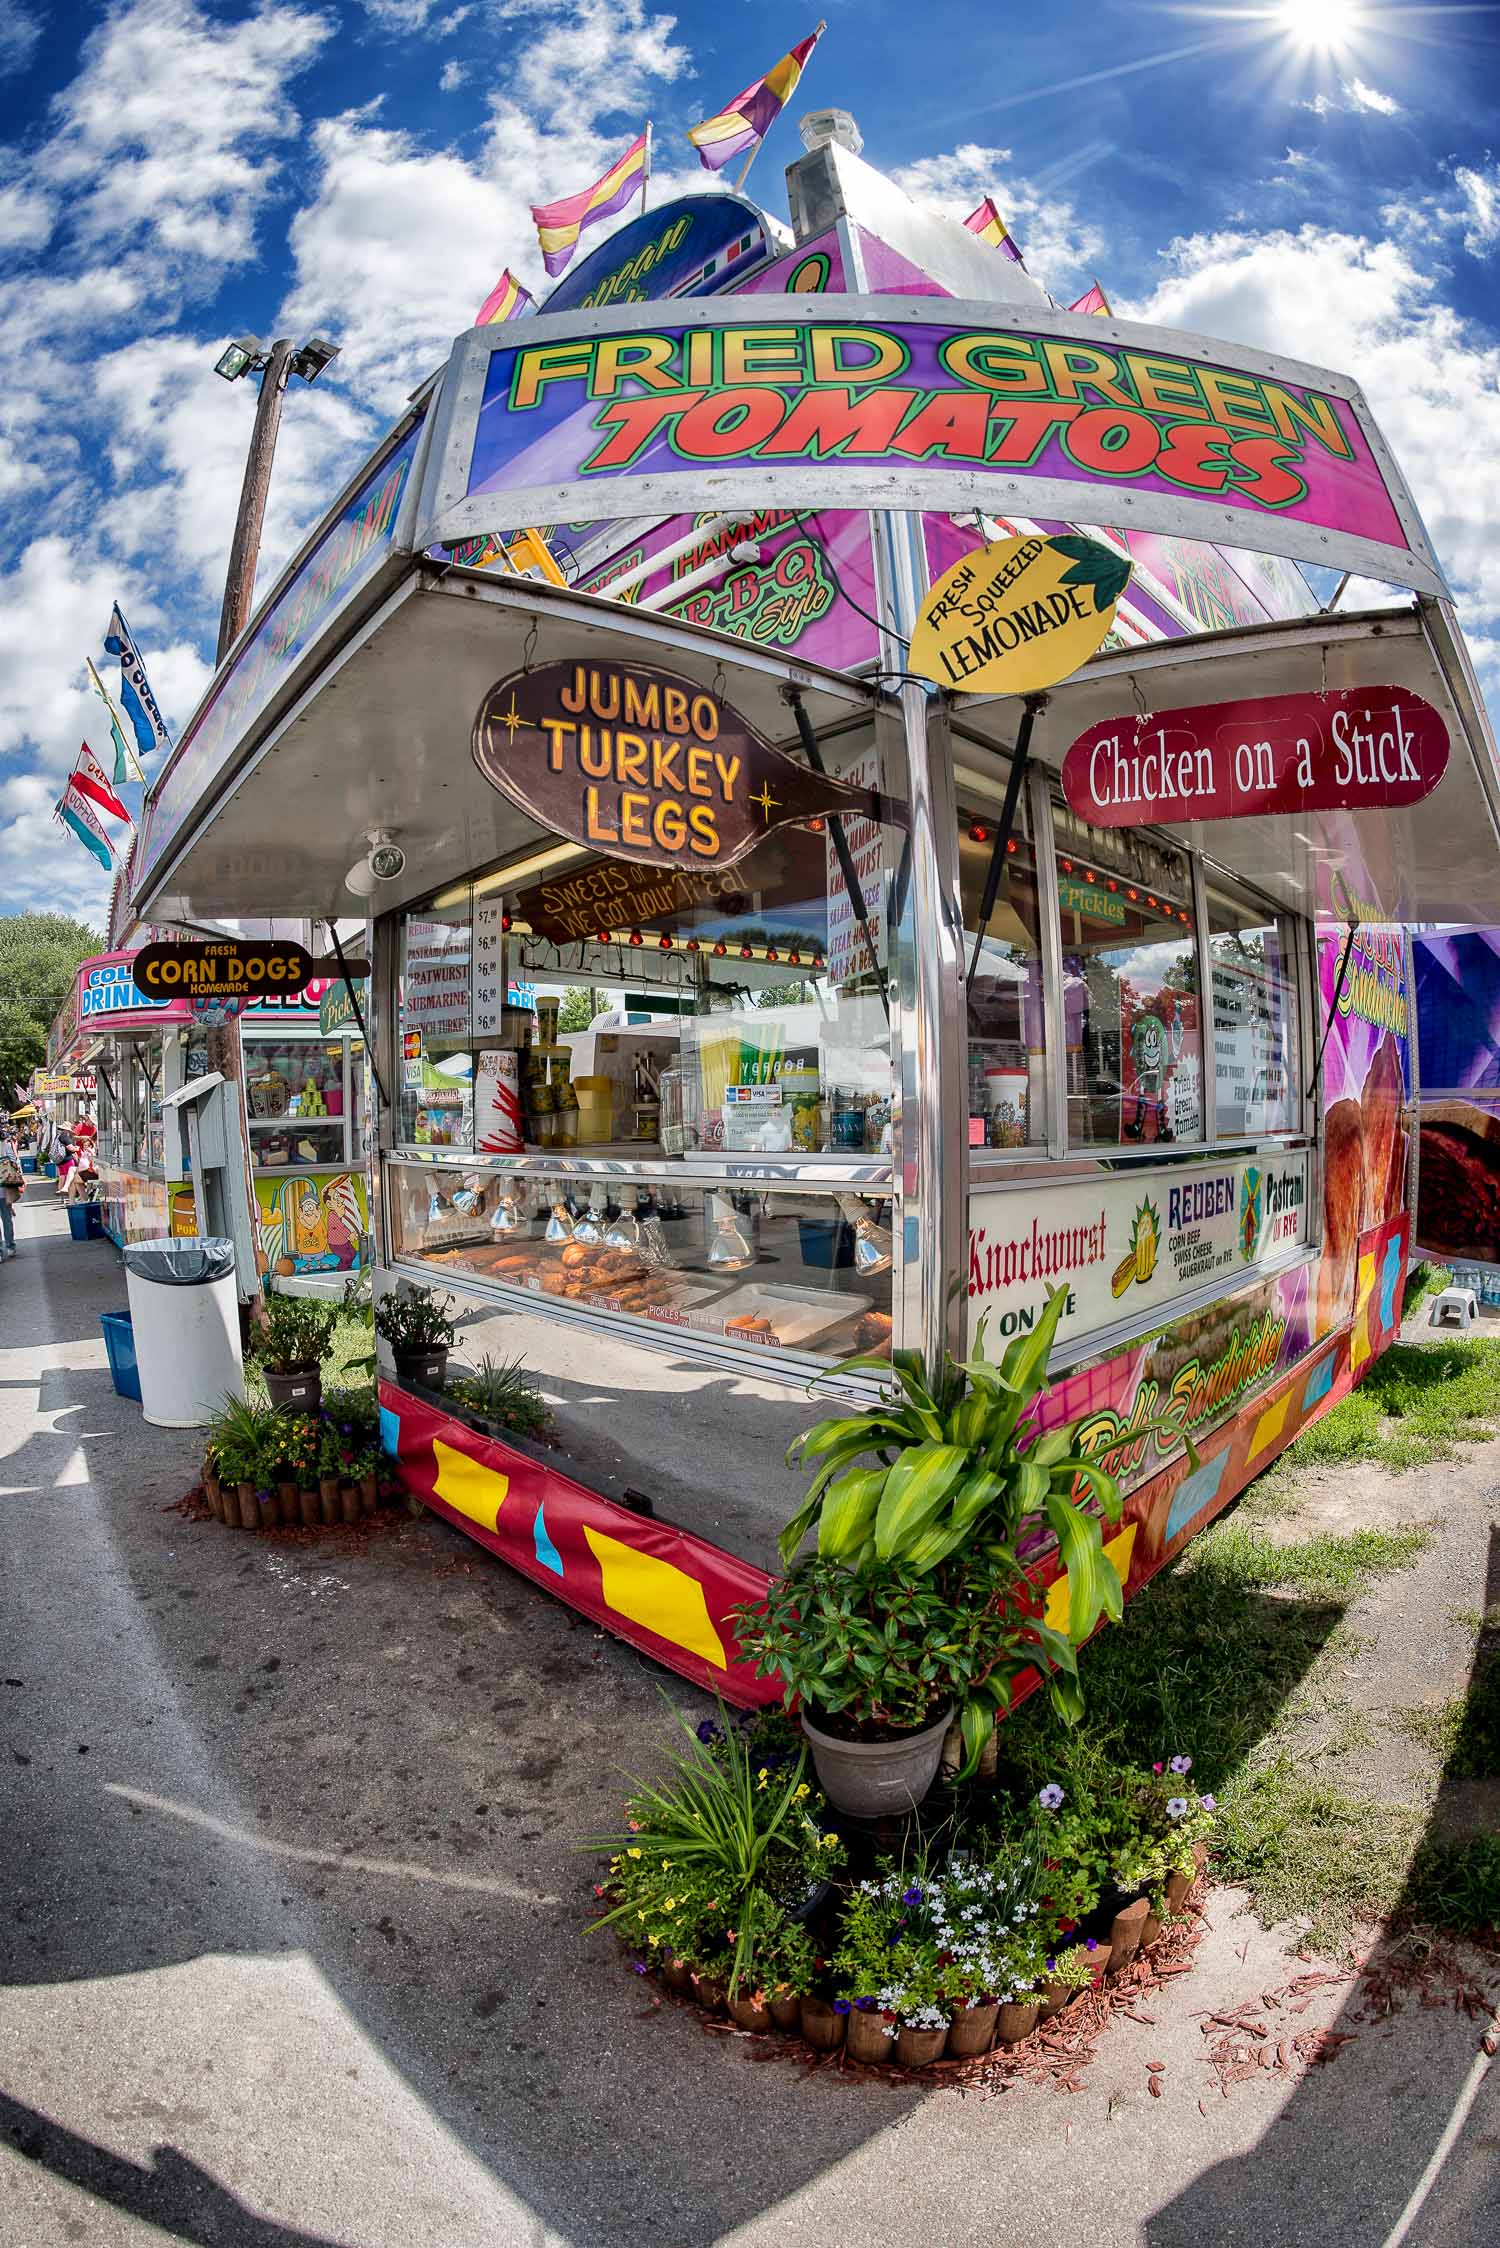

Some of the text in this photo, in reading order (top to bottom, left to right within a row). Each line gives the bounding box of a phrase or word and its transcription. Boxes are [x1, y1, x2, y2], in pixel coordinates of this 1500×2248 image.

[511, 327, 1355, 460] FRIED GREEN
[579, 387, 1306, 508] TOMATOES
[926, 566, 976, 631] FRESH
[961, 539, 1043, 626] SQUEEZED
[752, 581, 827, 640] Style
[940, 585, 1092, 683] LEMONADE
[560, 665, 719, 742] JUMBO
[541, 718, 740, 802] TURKEY
[1089, 705, 1421, 807] Chicken on a Stick
[586, 787, 721, 857] LEGS
[1068, 887, 1125, 919] Pickles
[205, 945, 237, 956] FRESH
[89, 965, 134, 987] COL
[146, 957, 301, 984] CORN DOGS
[82, 982, 173, 1016] DRINK
[191, 982, 249, 993] HOMEMADE
[407, 991, 468, 1013] SUBMARINE
[406, 1064, 421, 1080] VISA
[1175, 1097, 1192, 1115] Green
[1175, 1114, 1199, 1136] Tomato
[1168, 1176, 1235, 1230] REUBEN
[1267, 1162, 1304, 1215] Pastrami
[1283, 1212, 1297, 1237] RYE
[969, 1208, 1106, 1297] Knockwurst
[1169, 1230, 1200, 1252] CORN BEEF
[1174, 1241, 1212, 1267] SWISS CHEESE
[1179, 1256, 1215, 1281] SAUERKRAUT
[1223, 1249, 1232, 1264] RYE
[649, 1304, 680, 1321] PICKLES
[1000, 1305, 1034, 1336] ON
